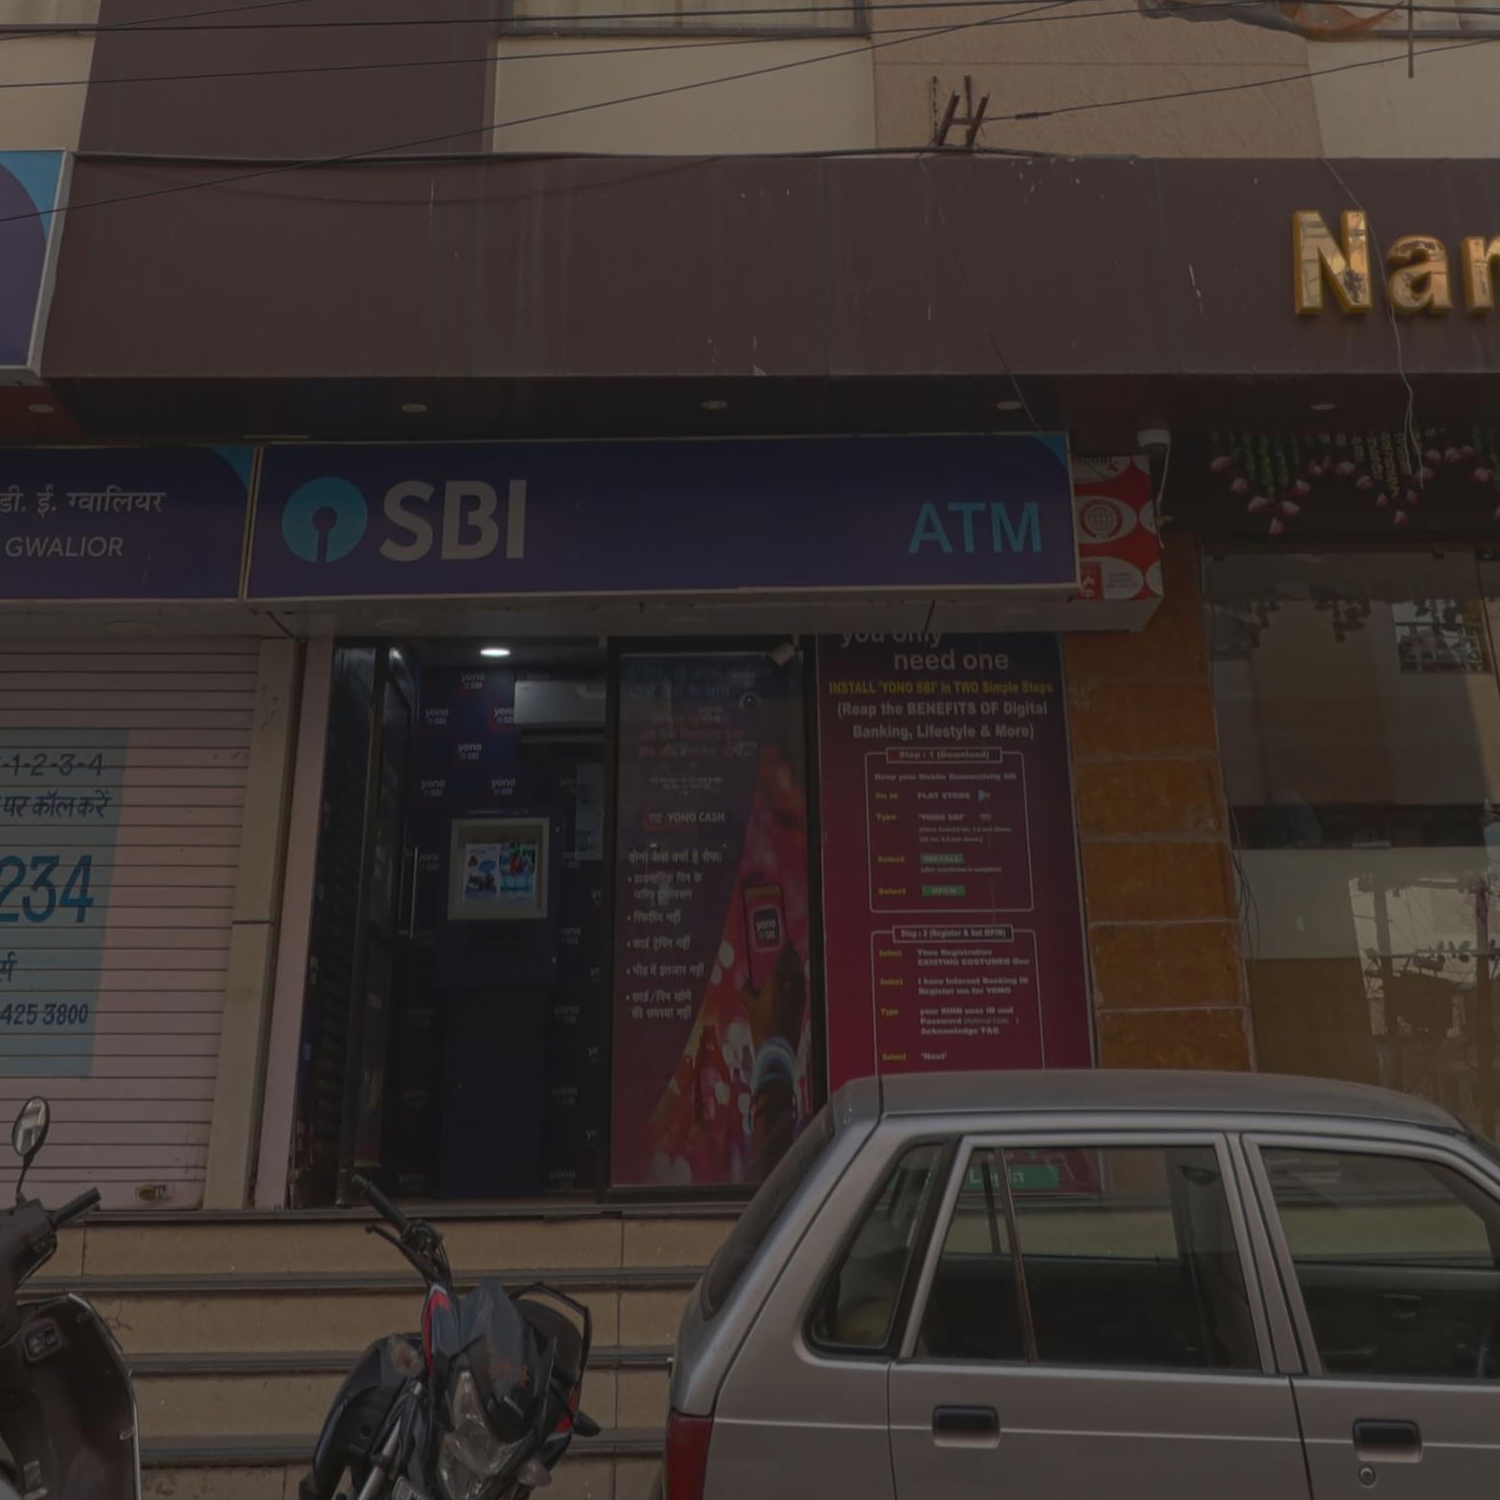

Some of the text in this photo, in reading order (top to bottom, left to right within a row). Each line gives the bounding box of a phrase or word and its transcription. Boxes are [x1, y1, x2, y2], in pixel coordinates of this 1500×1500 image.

[36, 483, 58, 519] ई.
[66, 484, 168, 513] ग्वालियर
[378, 478, 1043, 562] SBI ATM
[4, 535, 125, 558] GWALIOR
[840, 629, 943, 648] you only
[893, 649, 1010, 670] need one
[829, 681, 875, 695] INSTALL
[878, 681, 914, 695] 'YONO
[941, 682, 951, 694] in
[954, 681, 979, 695] TWO
[982, 681, 1019, 696] Simple
[1022, 681, 1053, 696] Steps
[425, 707, 449, 718] yono
[837, 701, 1048, 720] (Reap the BENEFITS OF Digital
[853, 723, 1035, 742] Banking, Lifestyle & More)
[458, 742, 482, 753] yono
[490, 778, 516, 789] yono
[0, 796, 31, 818] पर
[31, 789, 76, 818] कॉल
[76, 789, 113, 819] करें
[667, 812, 696, 823] YONO
[698, 812, 725, 823] CASH
[756, 918, 778, 931] yono
[0, 1003, 38, 1026] 425
[42, 1002, 89, 1025] 3800
